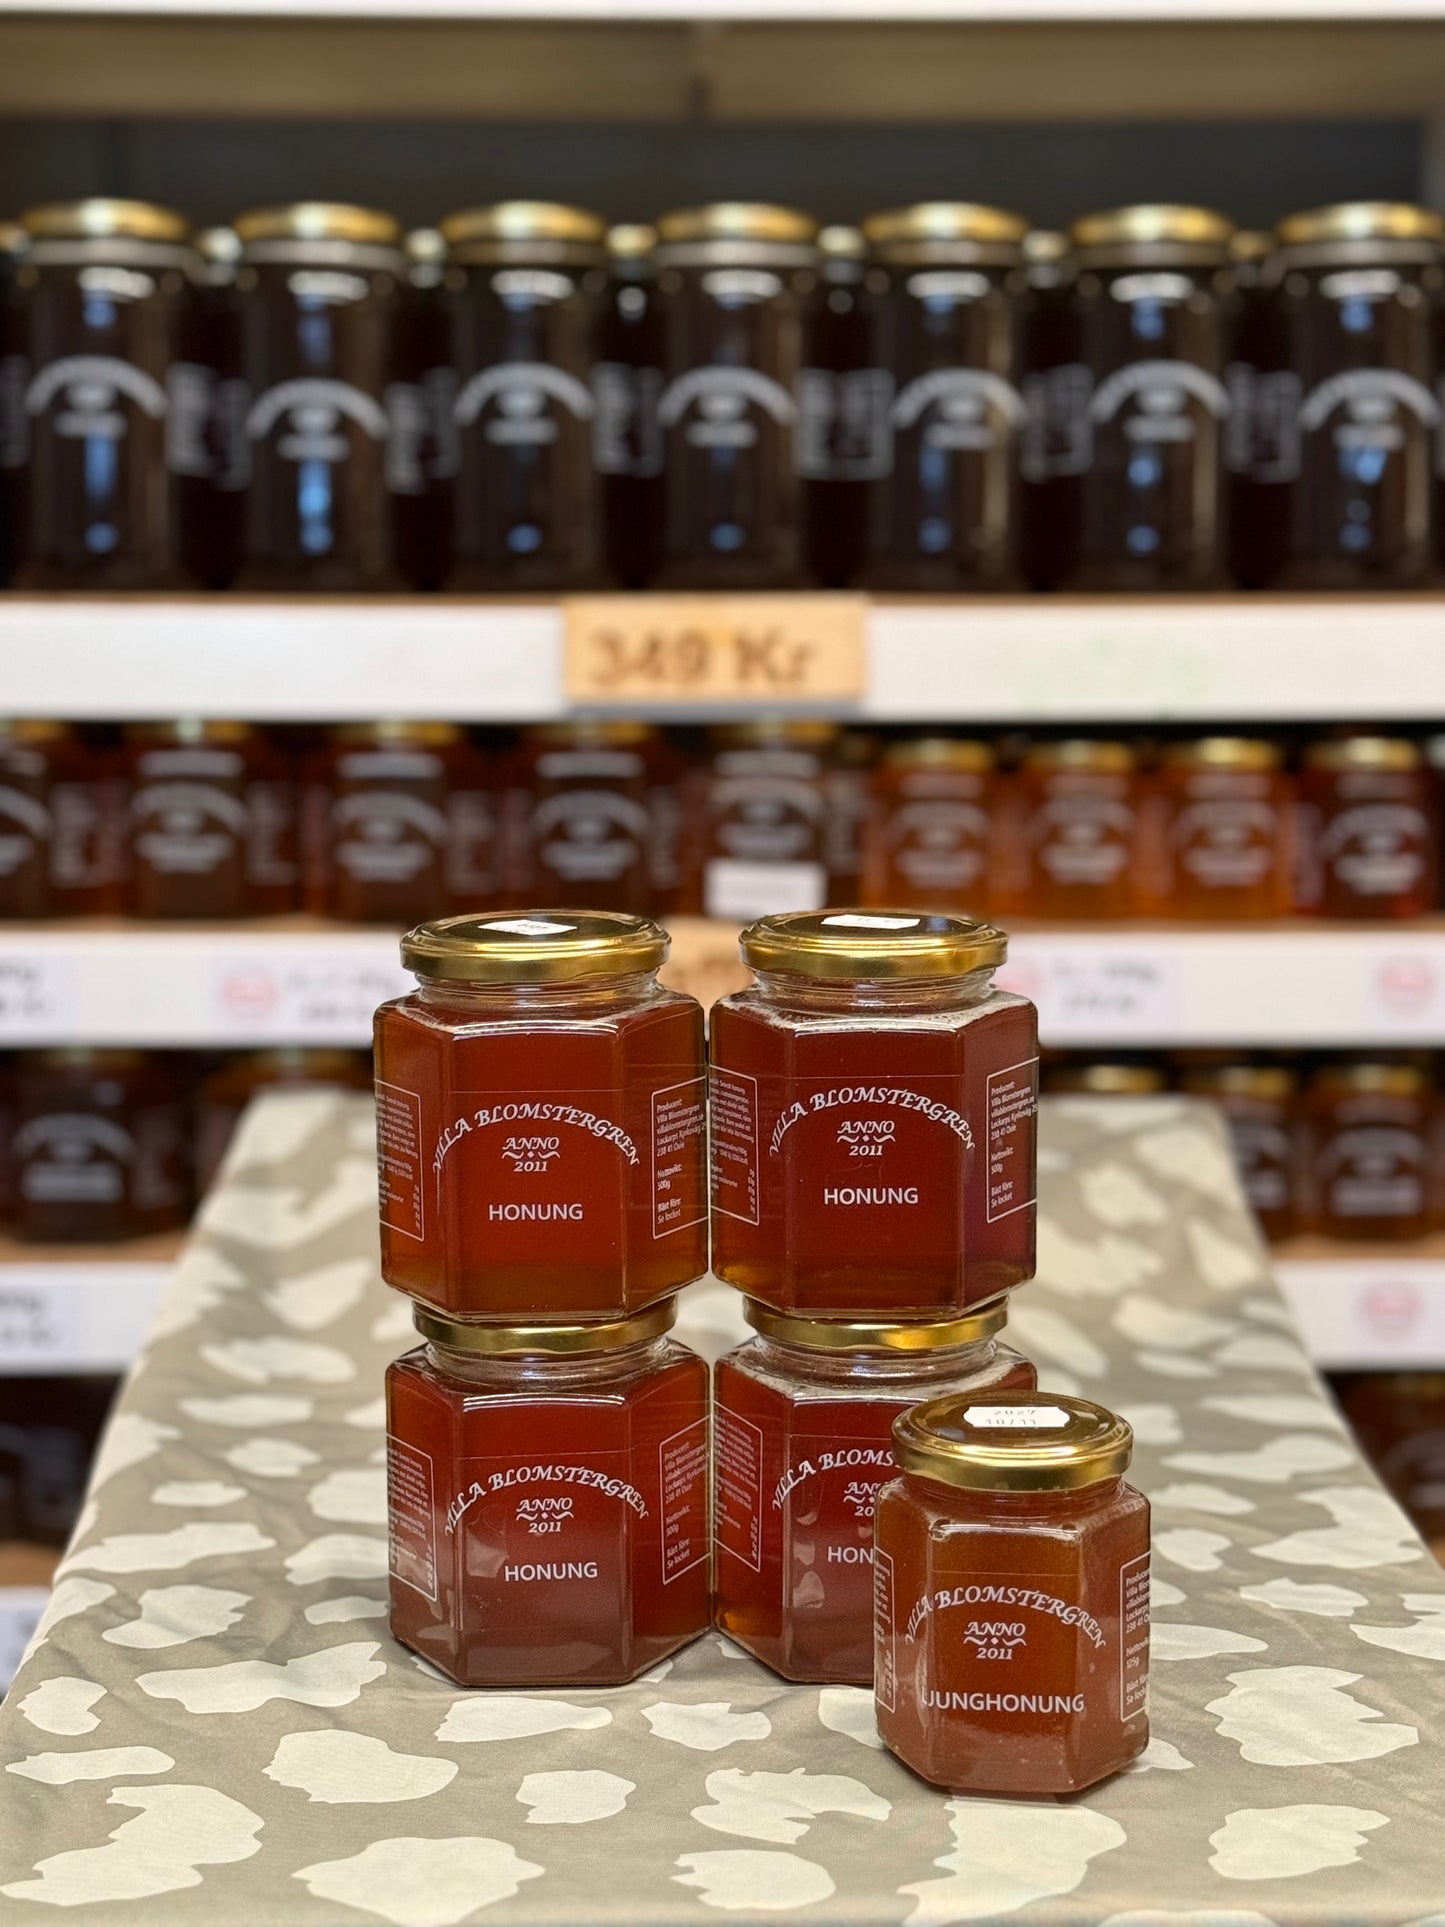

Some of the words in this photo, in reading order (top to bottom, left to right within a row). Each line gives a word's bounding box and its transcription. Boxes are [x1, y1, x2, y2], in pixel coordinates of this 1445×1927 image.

[769, 1102, 808, 1157] VILLA
[810, 1087, 975, 1151] BLOMSTERGREN
[837, 1120, 895, 1134] ANNO
[433, 1117, 473, 1172] VILLA
[474, 1103, 640, 1166] BLOMSTERGREN
[502, 1137, 560, 1150] ANNO
[849, 1145, 883, 1156] 2011
[514, 1161, 548, 1172] 2011
[824, 1188, 918, 1205] HONUNG
[489, 1204, 583, 1221] HONUNG
[772, 1460, 816, 1511] VILLA
[445, 1481, 487, 1536] VILLA
[488, 1465, 650, 1519] BLOMSTERGREN
[518, 1497, 573, 1512] ANNO
[528, 1522, 562, 1534] 2011
[828, 1546, 874, 1563] HON
[505, 1562, 598, 1582] HONUNG
[905, 1593, 933, 1646] VILLA
[935, 1586, 1106, 1649] BLOMSTERGREN
[964, 1621, 1025, 1635] ANNO
[976, 1647, 1012, 1660] 2011
